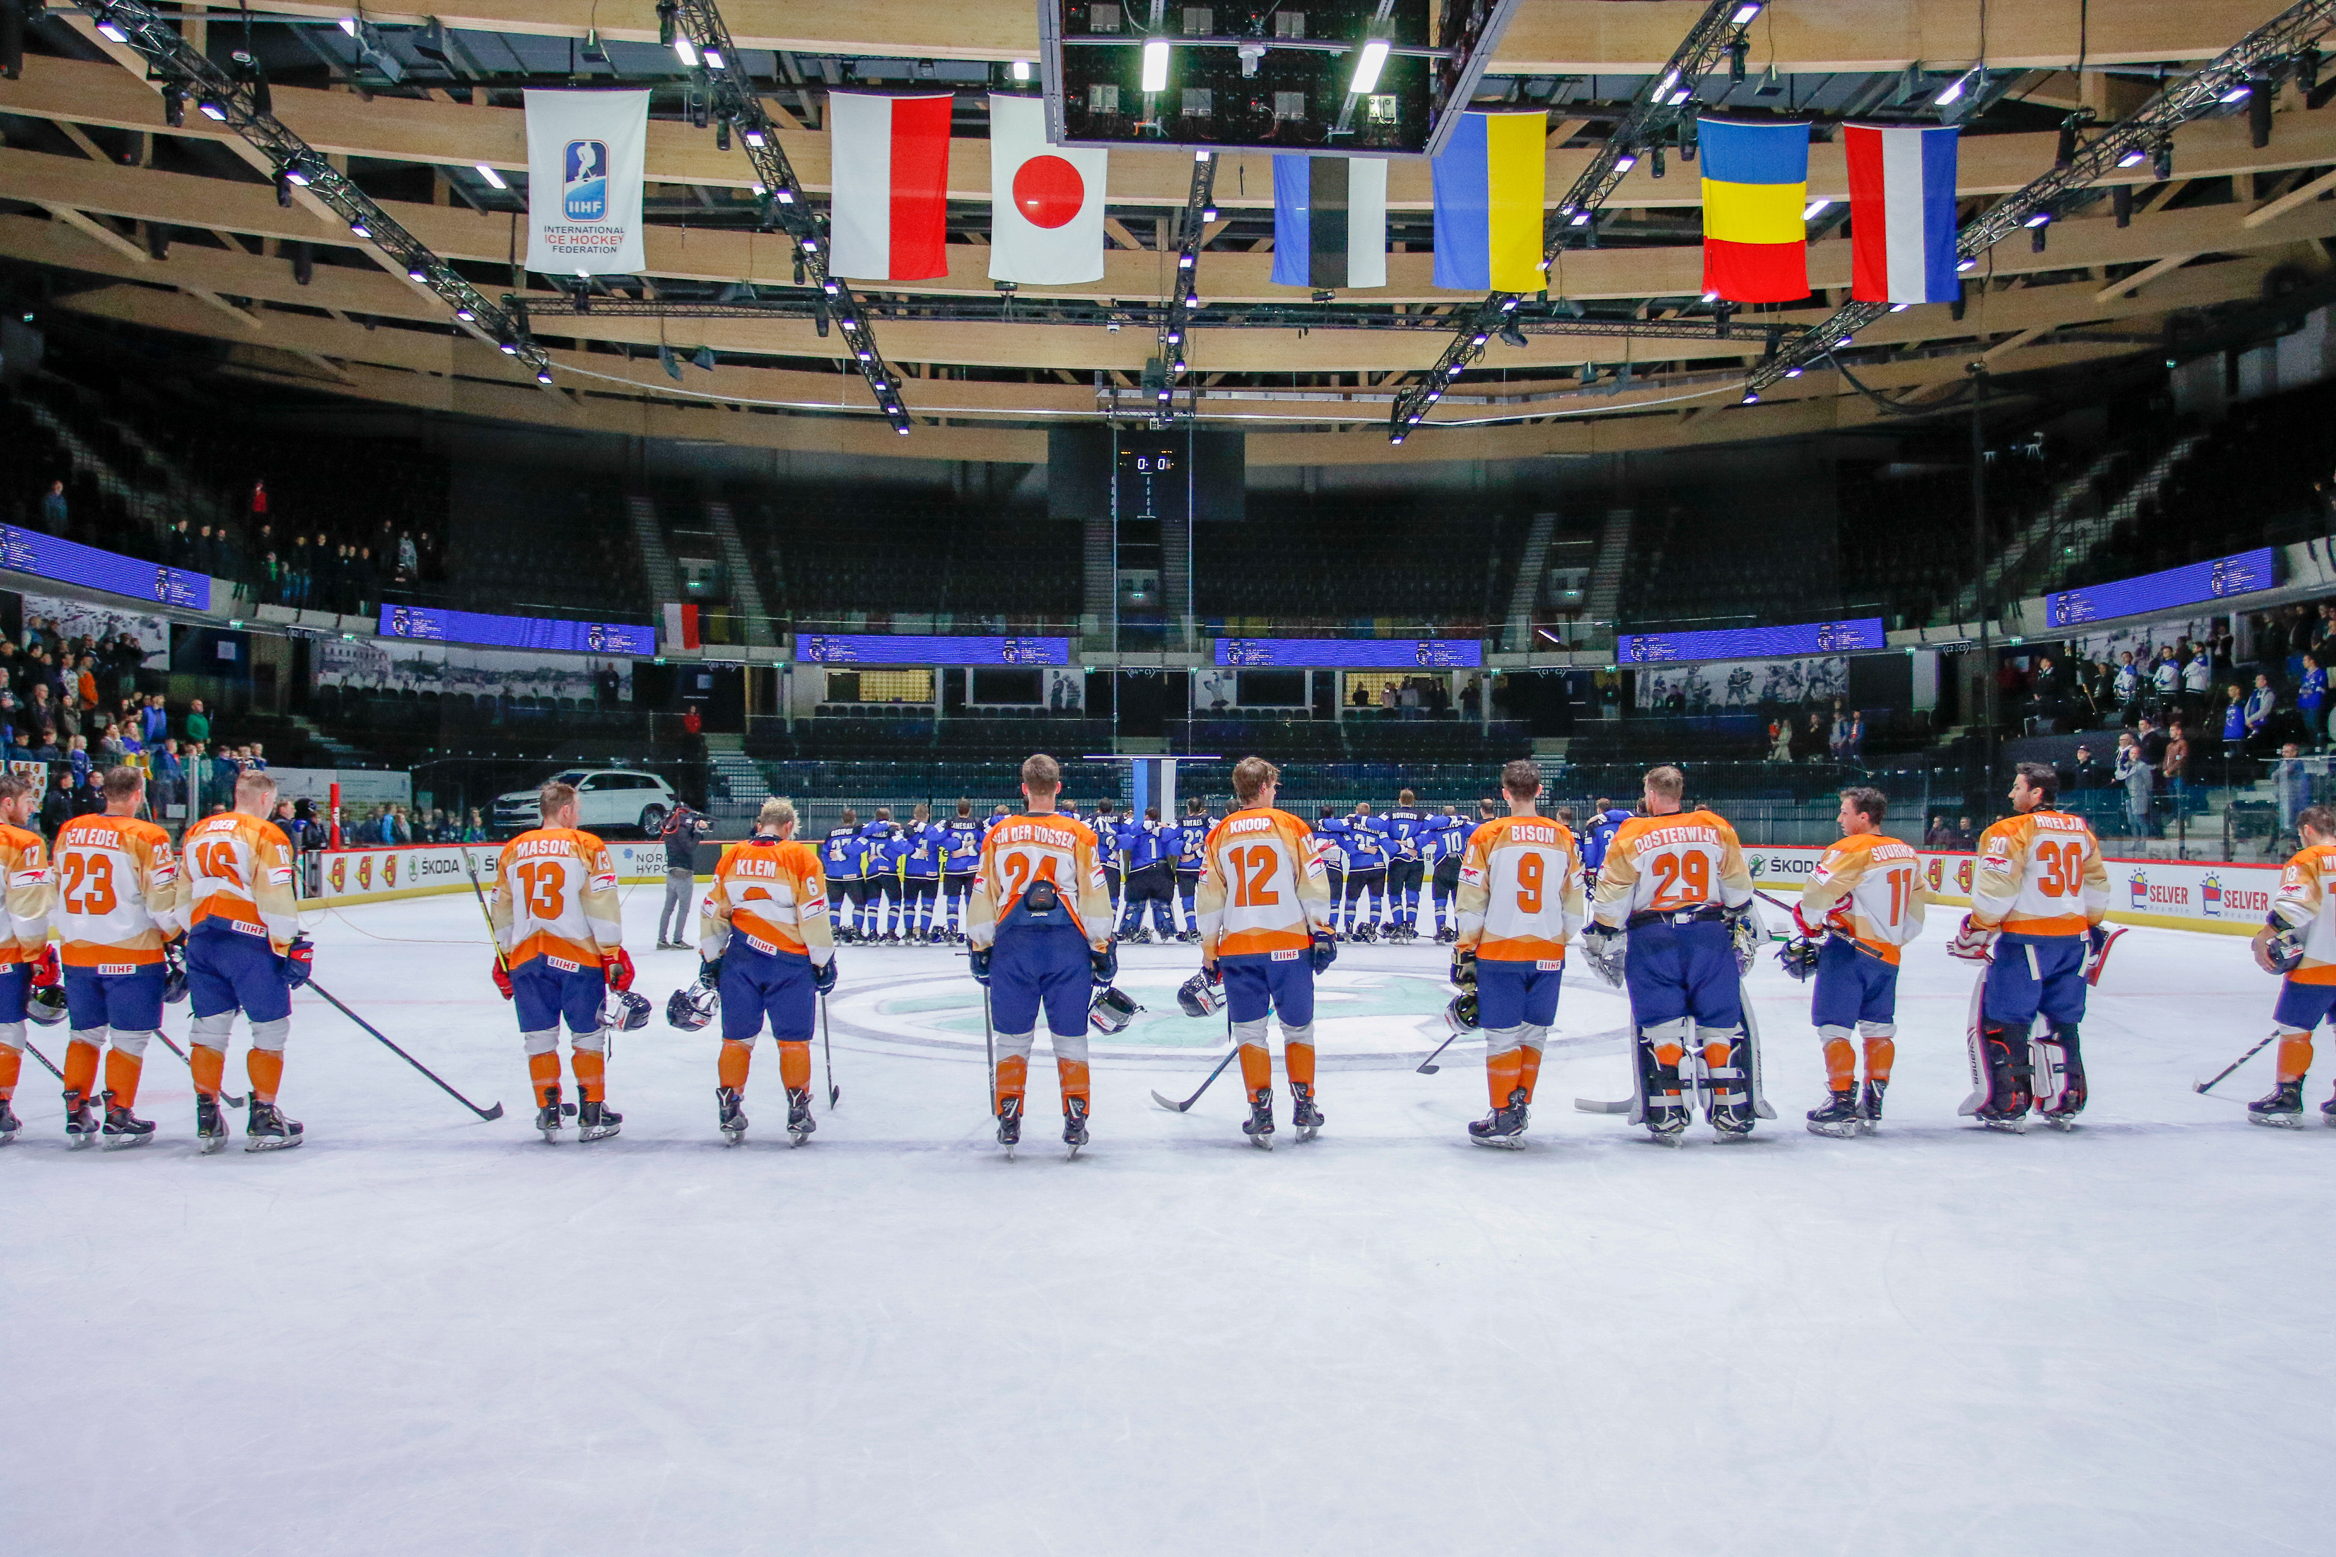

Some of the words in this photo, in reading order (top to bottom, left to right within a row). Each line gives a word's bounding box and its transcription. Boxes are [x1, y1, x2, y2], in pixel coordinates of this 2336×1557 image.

[568, 201, 602, 213] IIHF
[543, 225, 625, 234] INTERNATIONAL
[544, 234, 566, 245] ICE
[570, 234, 625, 245] HOCKEY
[552, 245, 617, 254] FEDERATION
[1229, 817, 1271, 835] KNOOP
[2033, 814, 2085, 832] HRELJA
[87, 828, 120, 849] EDEL
[1011, 824, 1032, 842] DER
[1034, 825, 1077, 850] VOSSEN
[1300, 832, 1319, 856] 12
[1511, 825, 1555, 844] BISON
[1634, 826, 1719, 854] OOSTERWIJK
[153, 842, 173, 866] 23
[516, 839, 571, 858] MASON
[1986, 836, 2007, 855] 30
[24, 845, 40, 867] 17
[421, 856, 460, 875] ŠKODA
[596, 850, 612, 871] 13
[736, 859, 777, 878] KLEM
[1228, 845, 1279, 908] 12
[1650, 849, 1710, 907] 29
[2036, 840, 2085, 898] 30
[2284, 865, 2298, 883] 18
[62, 852, 117, 916] 23
[516, 861, 566, 921] 13
[805, 876, 819, 897] 6
[1516, 852, 1545, 914] 9
[2149, 884, 2189, 905] SELVER
[2223, 889, 2269, 912] SELVER
[242, 923, 265, 935] IIHF
[754, 940, 775, 953] IIHF
[1279, 950, 1297, 960] IIHF
[555, 958, 577, 971] IIHF
[1544, 961, 1560, 970] IIHF
